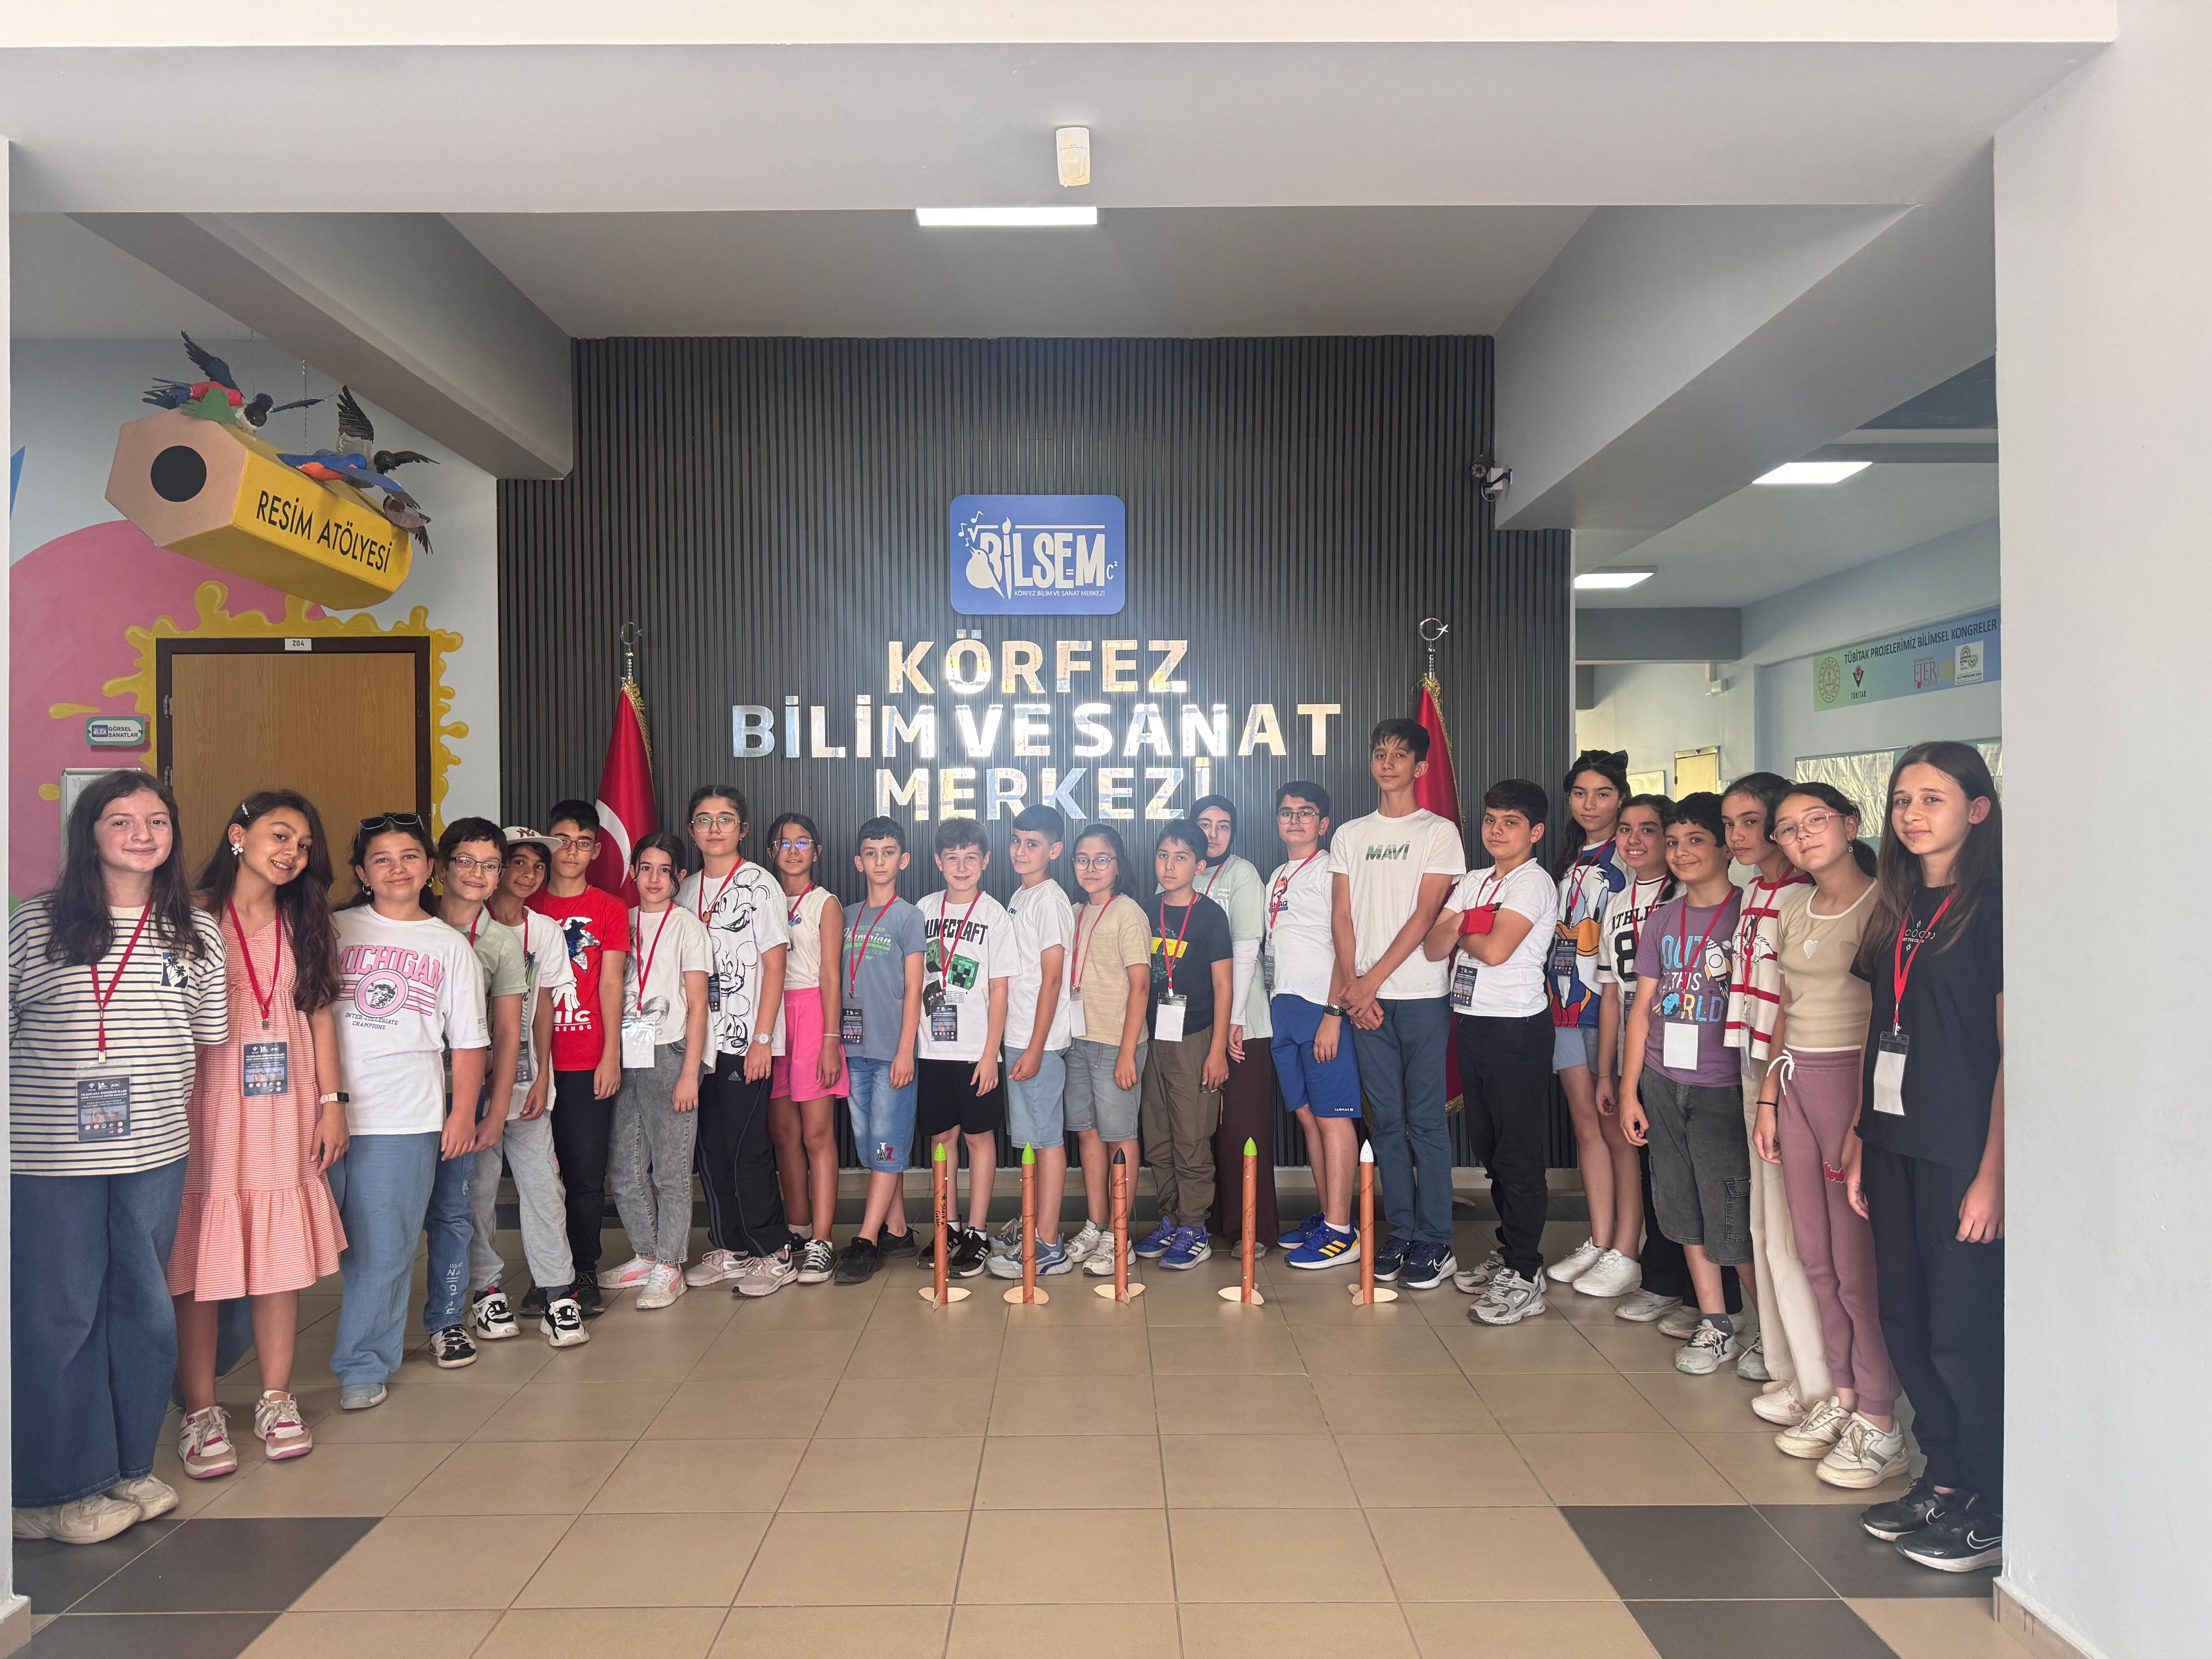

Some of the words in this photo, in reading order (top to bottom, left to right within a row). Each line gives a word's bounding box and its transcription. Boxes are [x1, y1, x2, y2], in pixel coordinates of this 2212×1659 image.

[256, 490, 313, 540] RESİM
[317, 518, 392, 573] ATÖLYESİ
[888, 629, 1188, 693] KÖRFEZ
[1844, 649, 1869, 664] TÜBİTAK
[1871, 636, 1916, 658] PROJELERİMİZ
[1917, 630, 1949, 647] BİLİMSEL
[1951, 619, 1997, 639] KONGRELER
[733, 695, 935, 758] BİLİM
[955, 704, 1051, 757] VE
[1074, 703, 1341, 757] SANAT
[876, 757, 1211, 820] MERKEZİ
[1365, 841, 1411, 861] MAVİ
[1662, 935, 1710, 969] OUT
